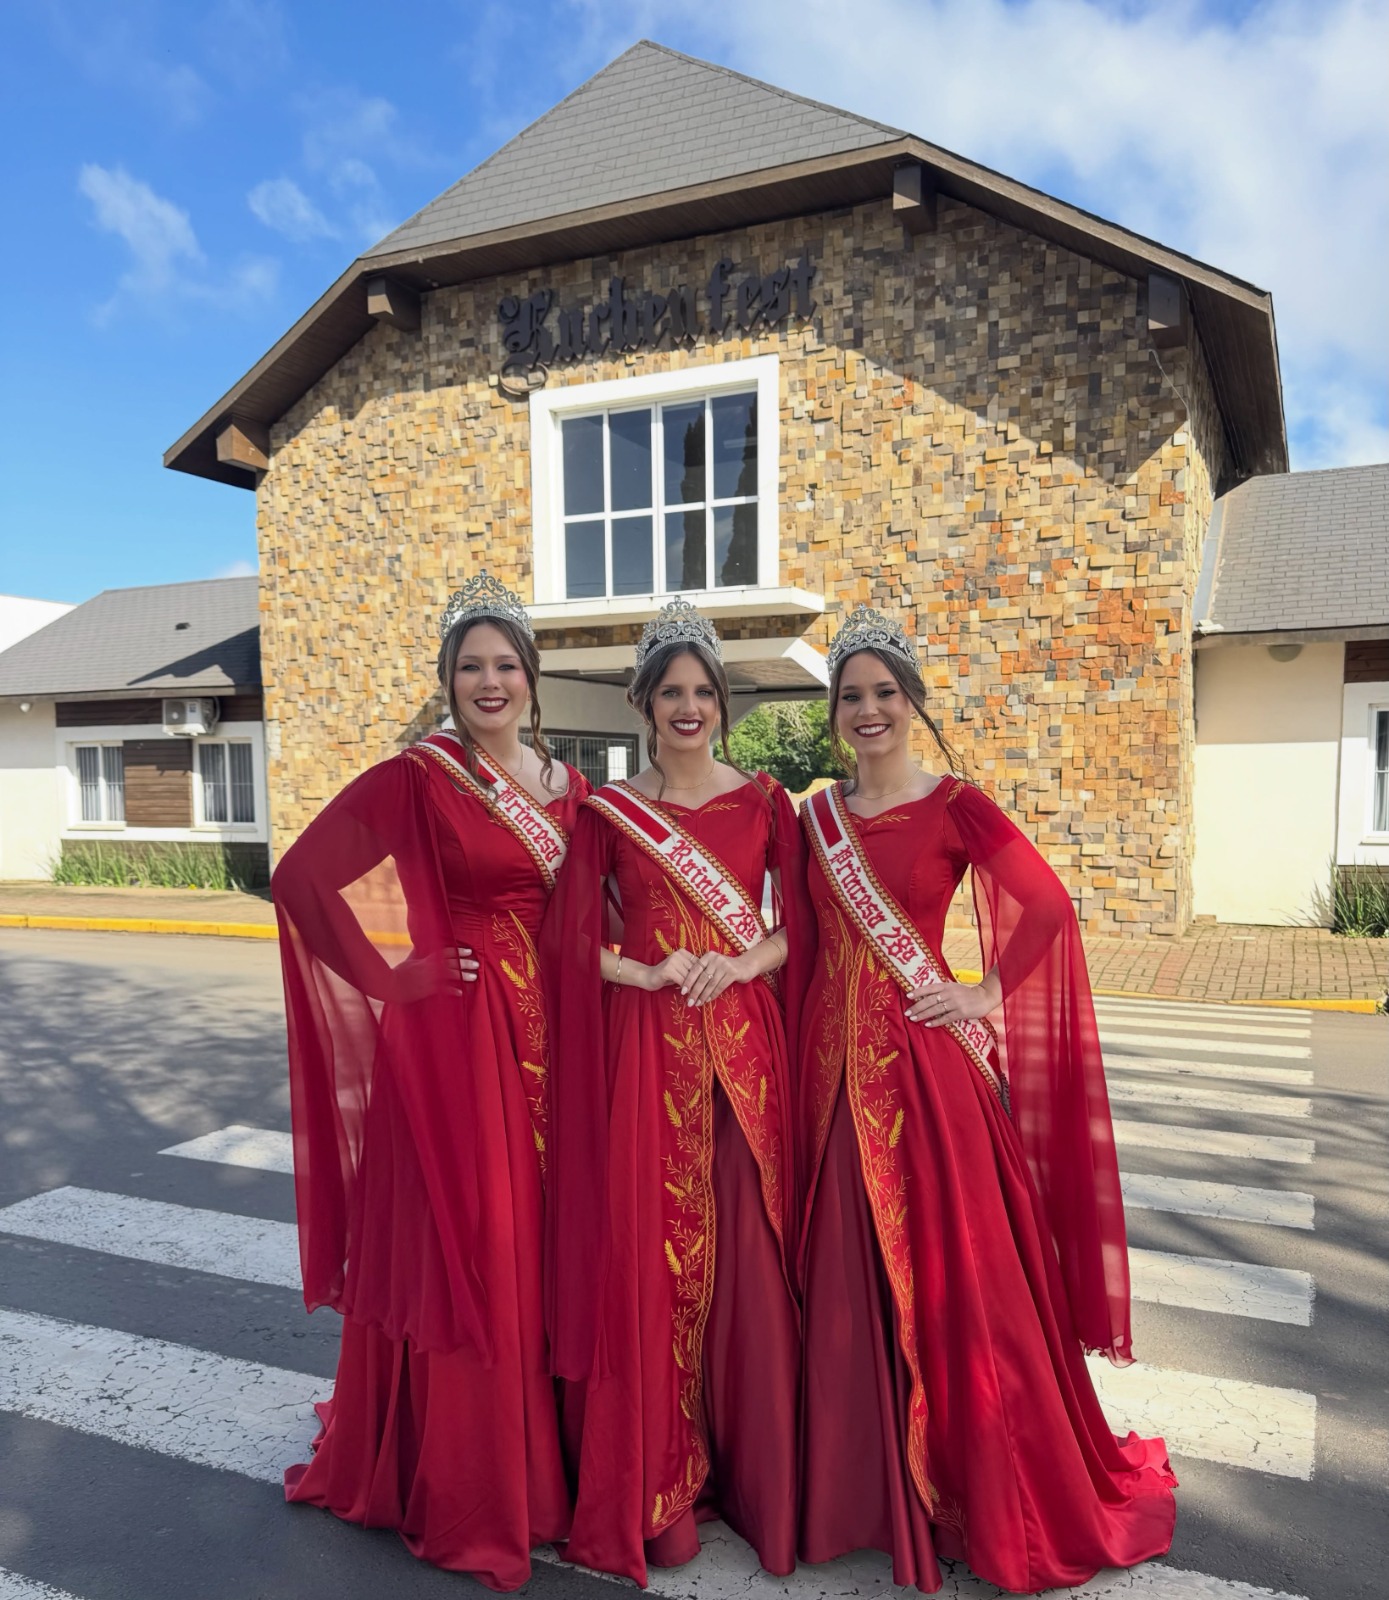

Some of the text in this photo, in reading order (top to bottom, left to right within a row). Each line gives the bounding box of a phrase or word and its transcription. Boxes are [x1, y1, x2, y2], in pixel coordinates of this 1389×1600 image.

[497, 786, 562, 863] Princesa
[665, 839, 731, 912] Rainha
[829, 844, 888, 930] Princesa
